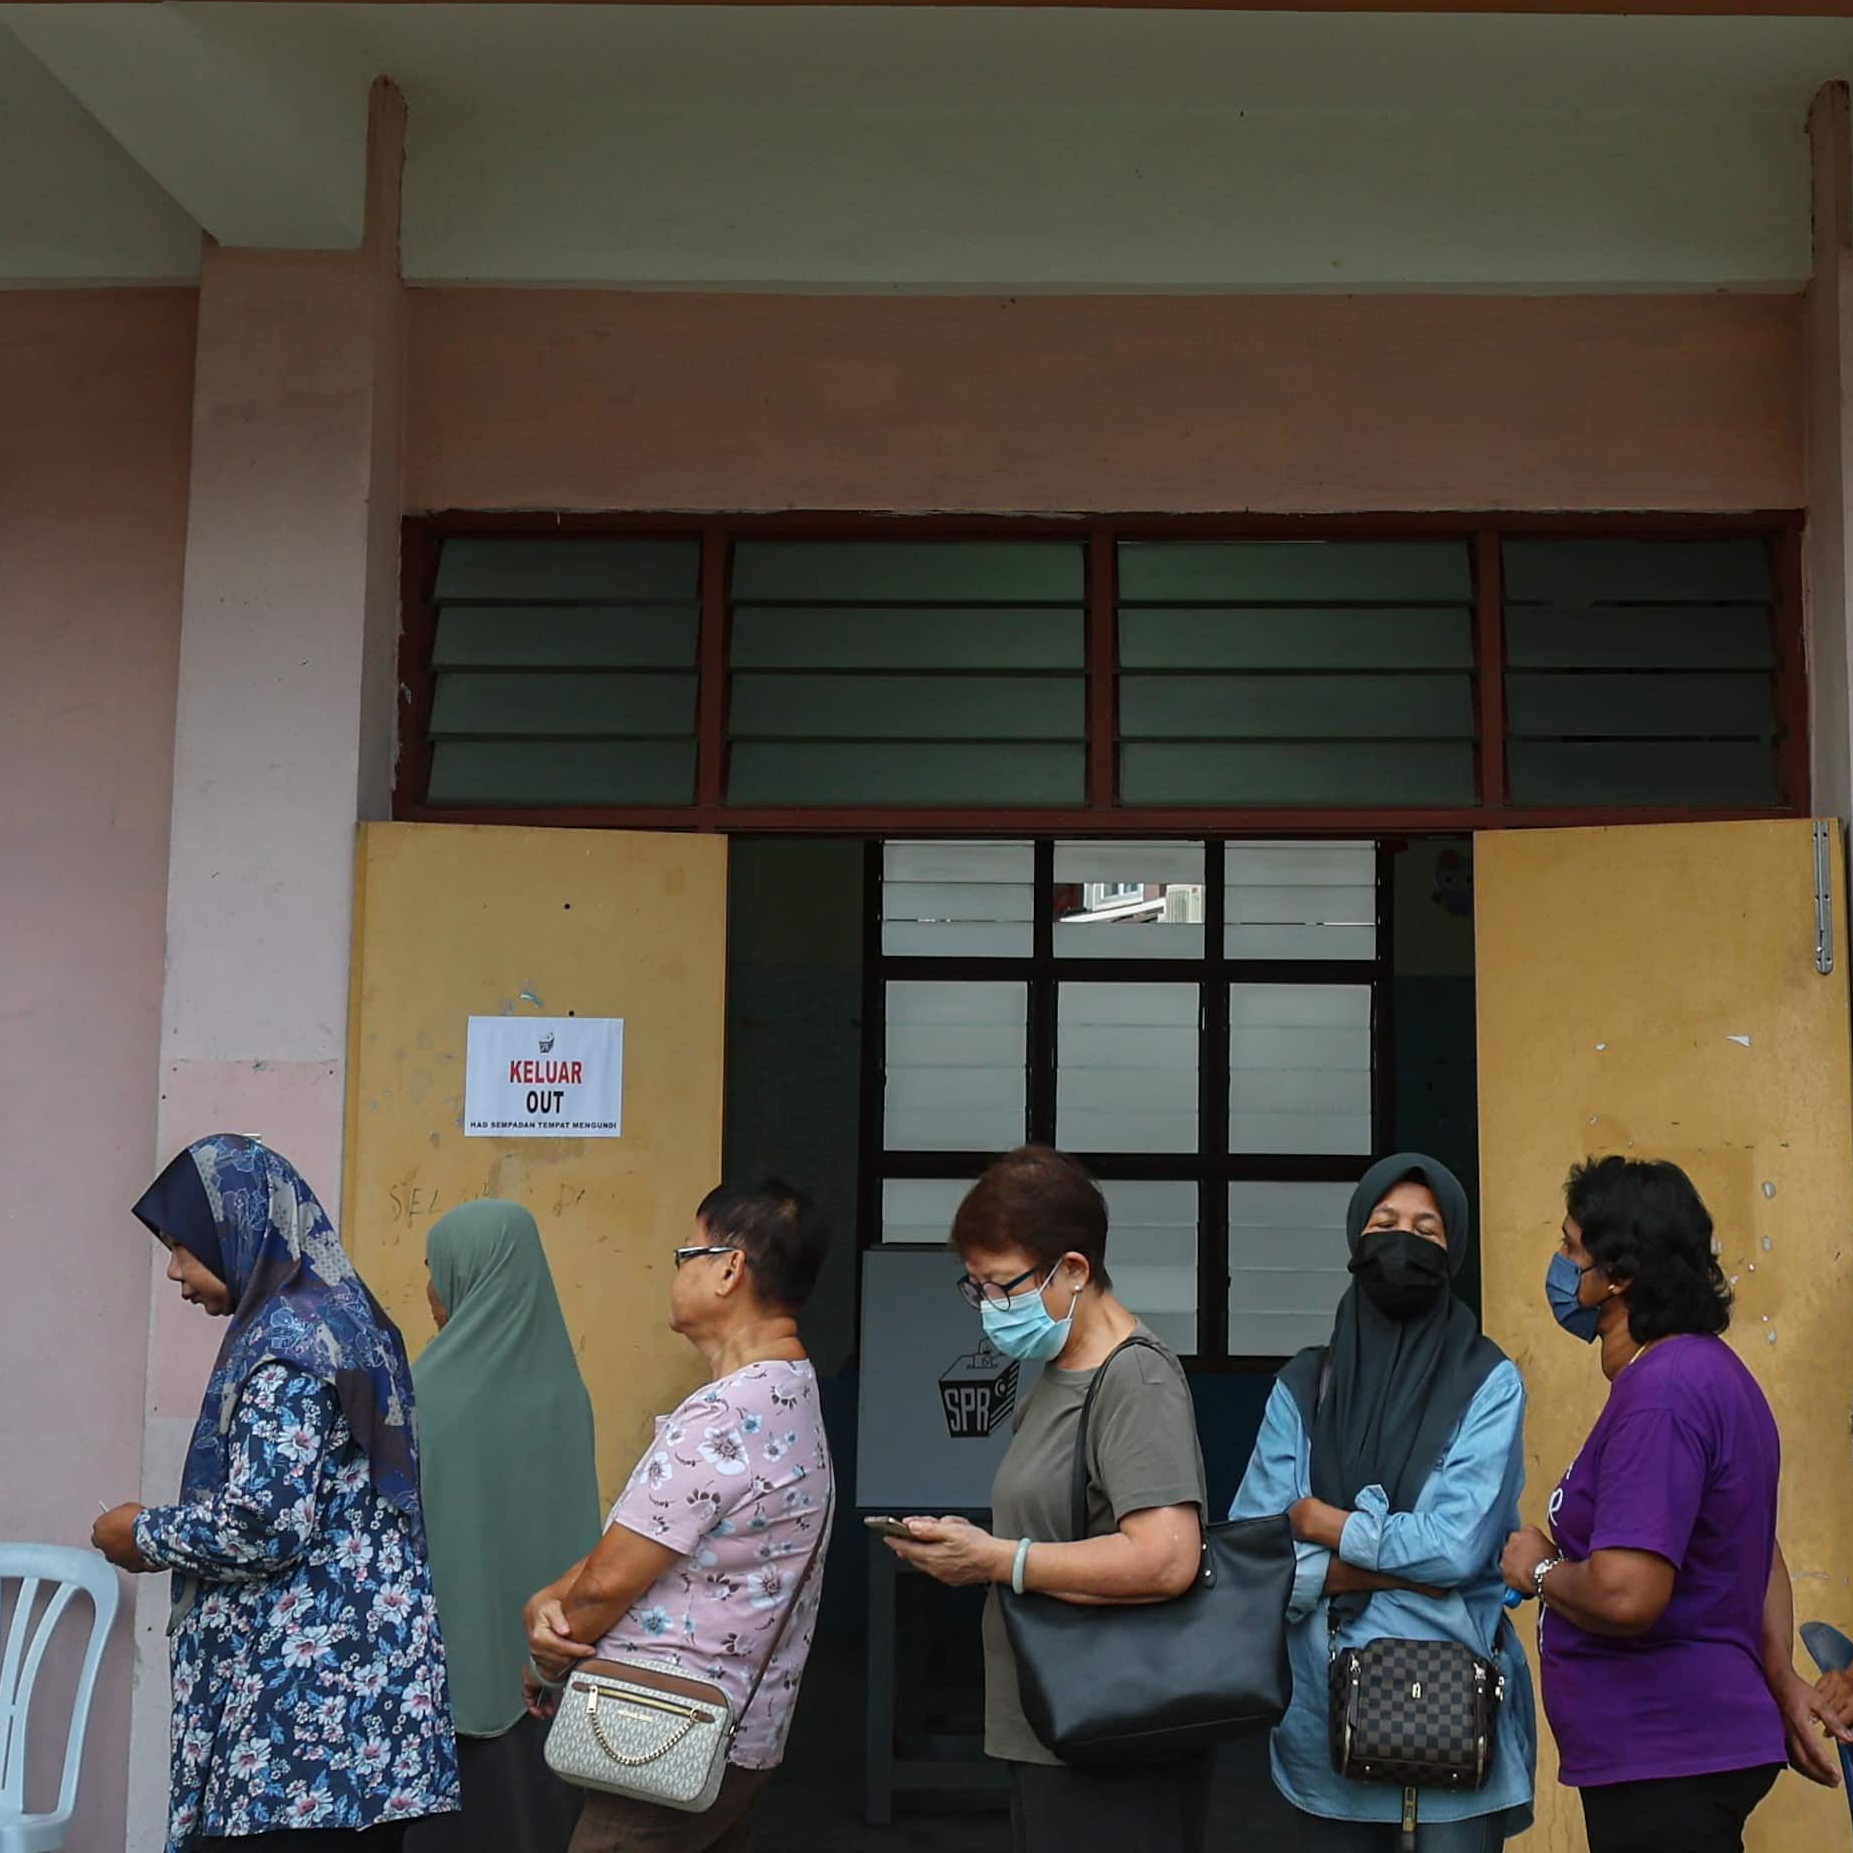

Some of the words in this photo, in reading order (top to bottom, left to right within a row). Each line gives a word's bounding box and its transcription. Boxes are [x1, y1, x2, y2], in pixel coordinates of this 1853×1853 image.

[510, 1060, 582, 1084] KELUAR
[526, 1090, 564, 1114] OUT
[944, 1388, 991, 1432] SPR
